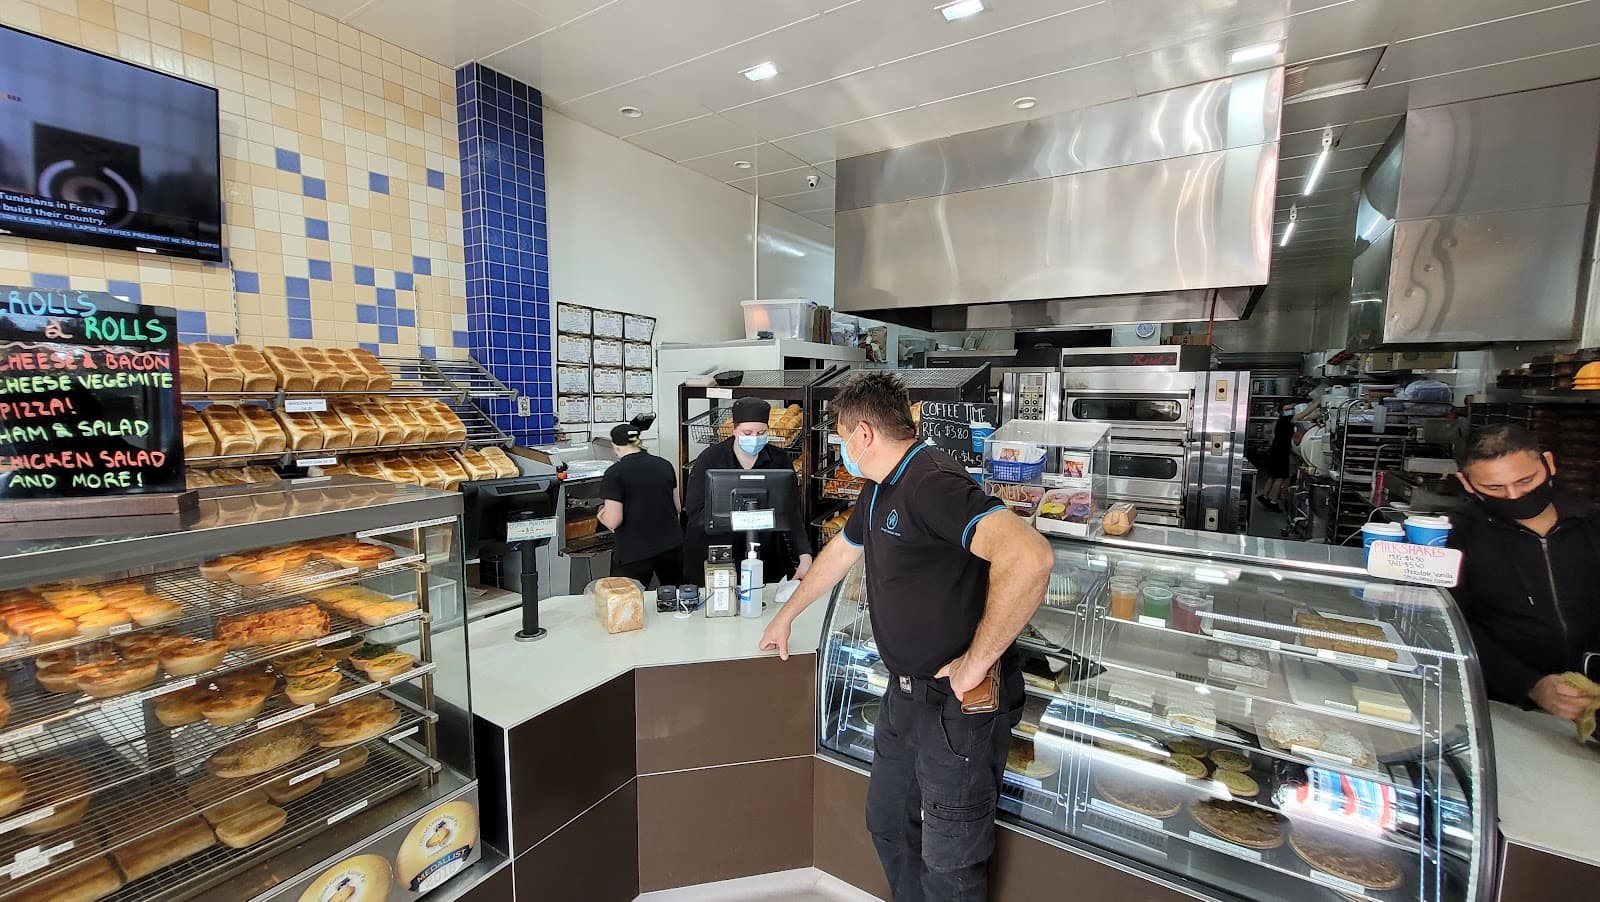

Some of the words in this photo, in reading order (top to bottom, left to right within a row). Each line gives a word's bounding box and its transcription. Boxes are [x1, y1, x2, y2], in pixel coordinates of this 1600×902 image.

[0, 191, 54, 208] Tunisians
[56, 201, 67, 210] in
[69, 202, 105, 215] France
[2, 203, 32, 215] build
[35, 208, 62, 218] their
[64, 214, 107, 226] country.
[0, 290, 97, 317] ROLLS
[84, 316, 168, 343] ROLLS
[83, 352, 97, 369] &
[105, 353, 170, 370] BACON
[78, 372, 174, 390] VEGEMITE
[0, 397, 77, 420] PIZZA!
[921, 401, 960, 418] COFFEE
[964, 403, 987, 423] TIME
[0, 425, 48, 445] HAM
[52, 422, 73, 438] &
[77, 418, 150, 438] SALAD
[0, 450, 94, 471] CHICKEN
[100, 450, 166, 468] SALAD
[8, 473, 57, 489] AND
[416, 849, 465, 883] MEDALLIST
